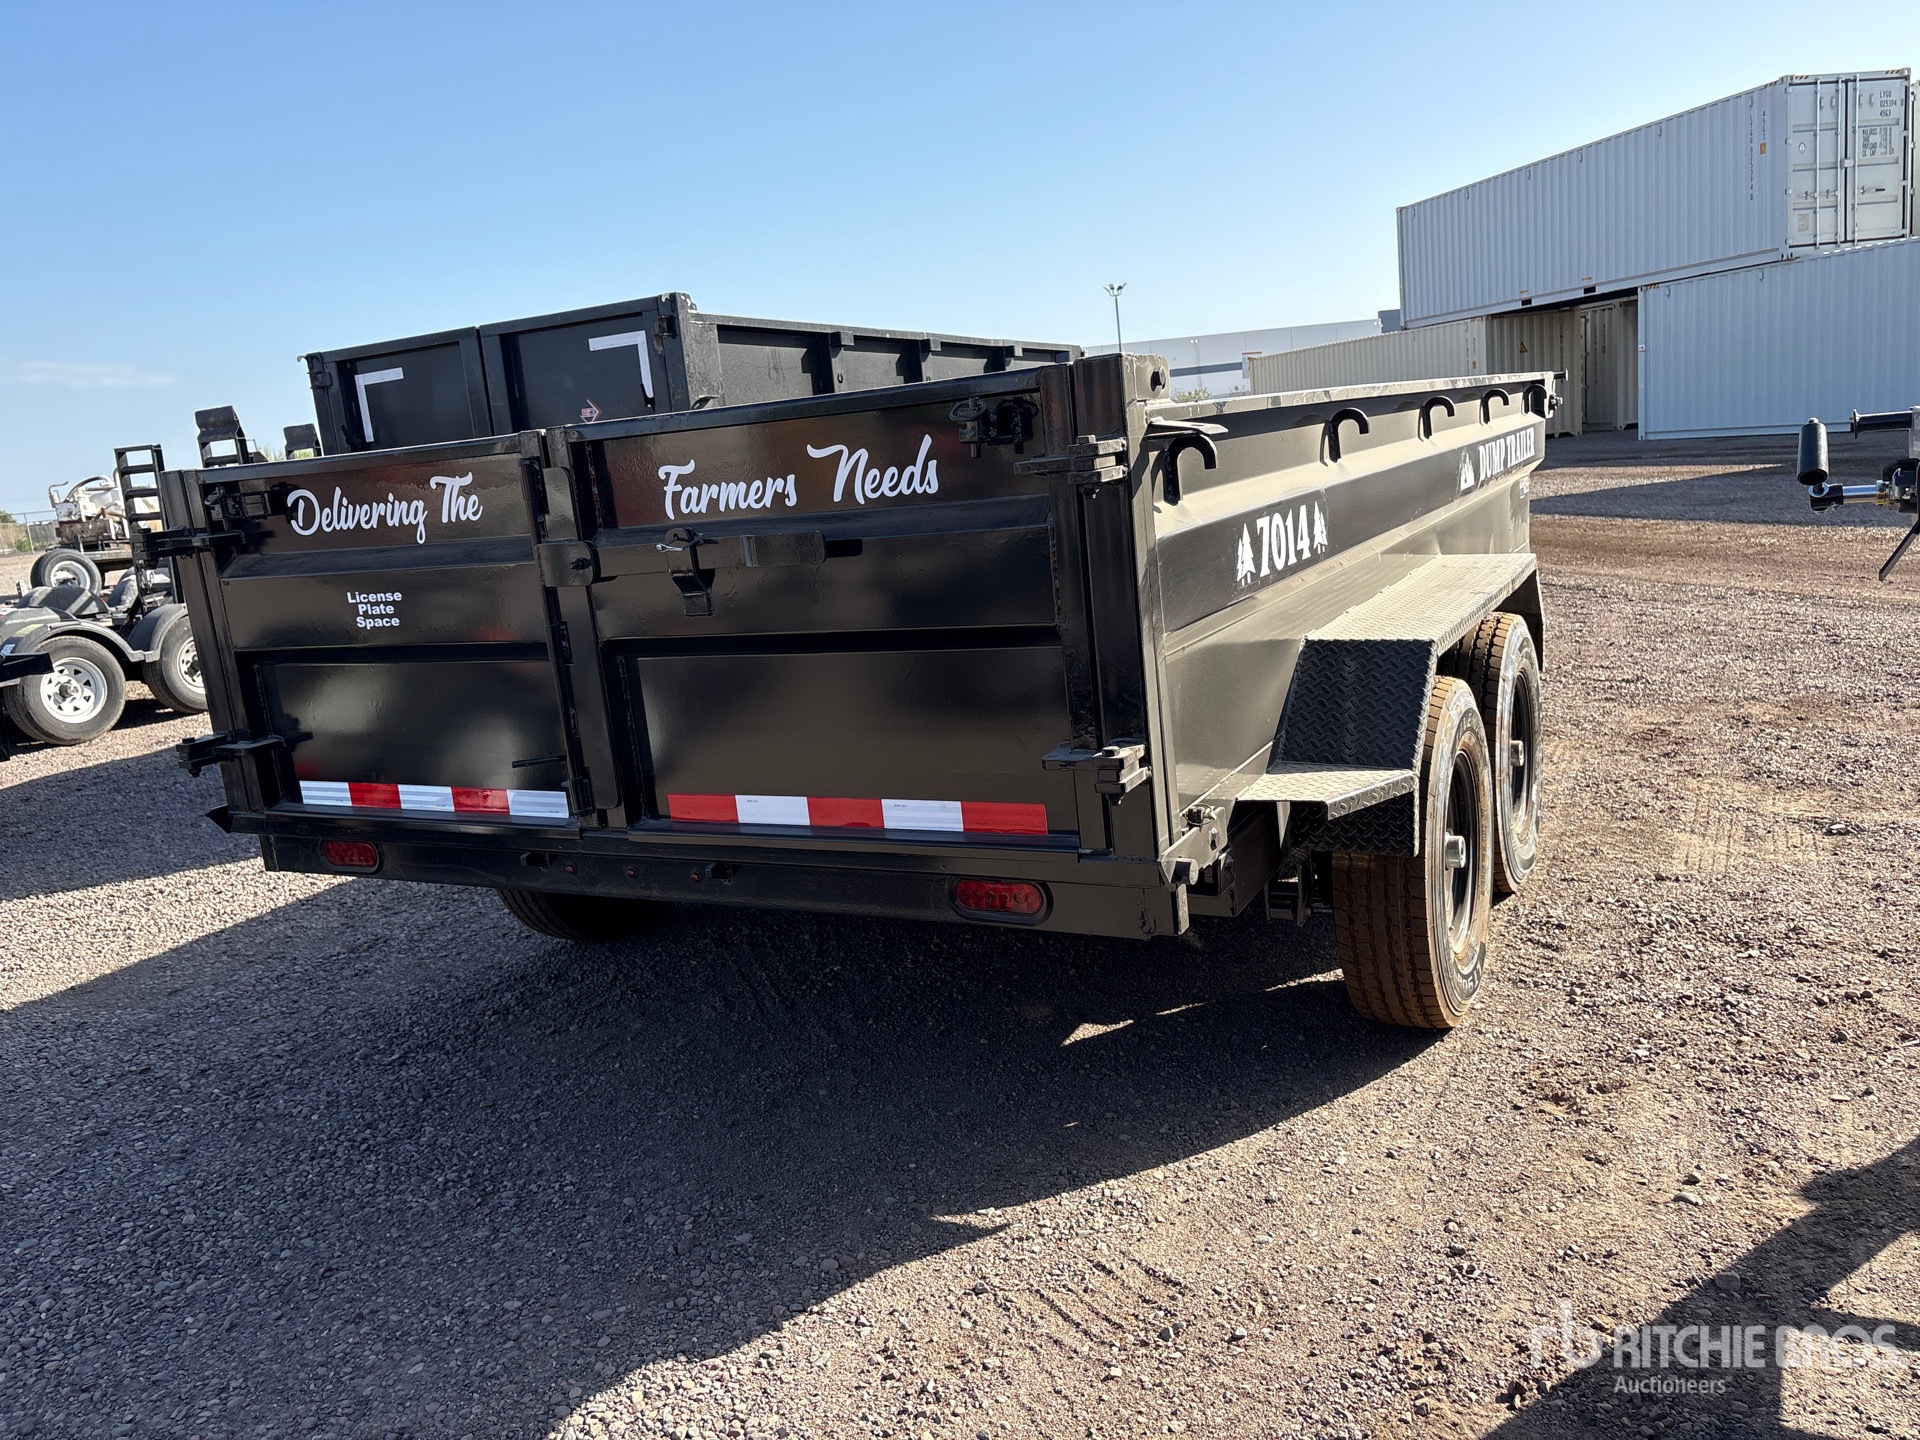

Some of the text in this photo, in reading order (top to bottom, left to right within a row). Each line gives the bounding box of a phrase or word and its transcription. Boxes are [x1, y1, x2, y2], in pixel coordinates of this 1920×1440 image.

[658, 434, 939, 520] Farmers Needs
[1478, 438, 1505, 482] DUMP
[287, 472, 483, 545] Delivering The
[1256, 504, 1311, 578] 7014
[346, 591, 403, 604] License
[357, 603, 395, 616] Plate
[356, 616, 400, 630] Space
